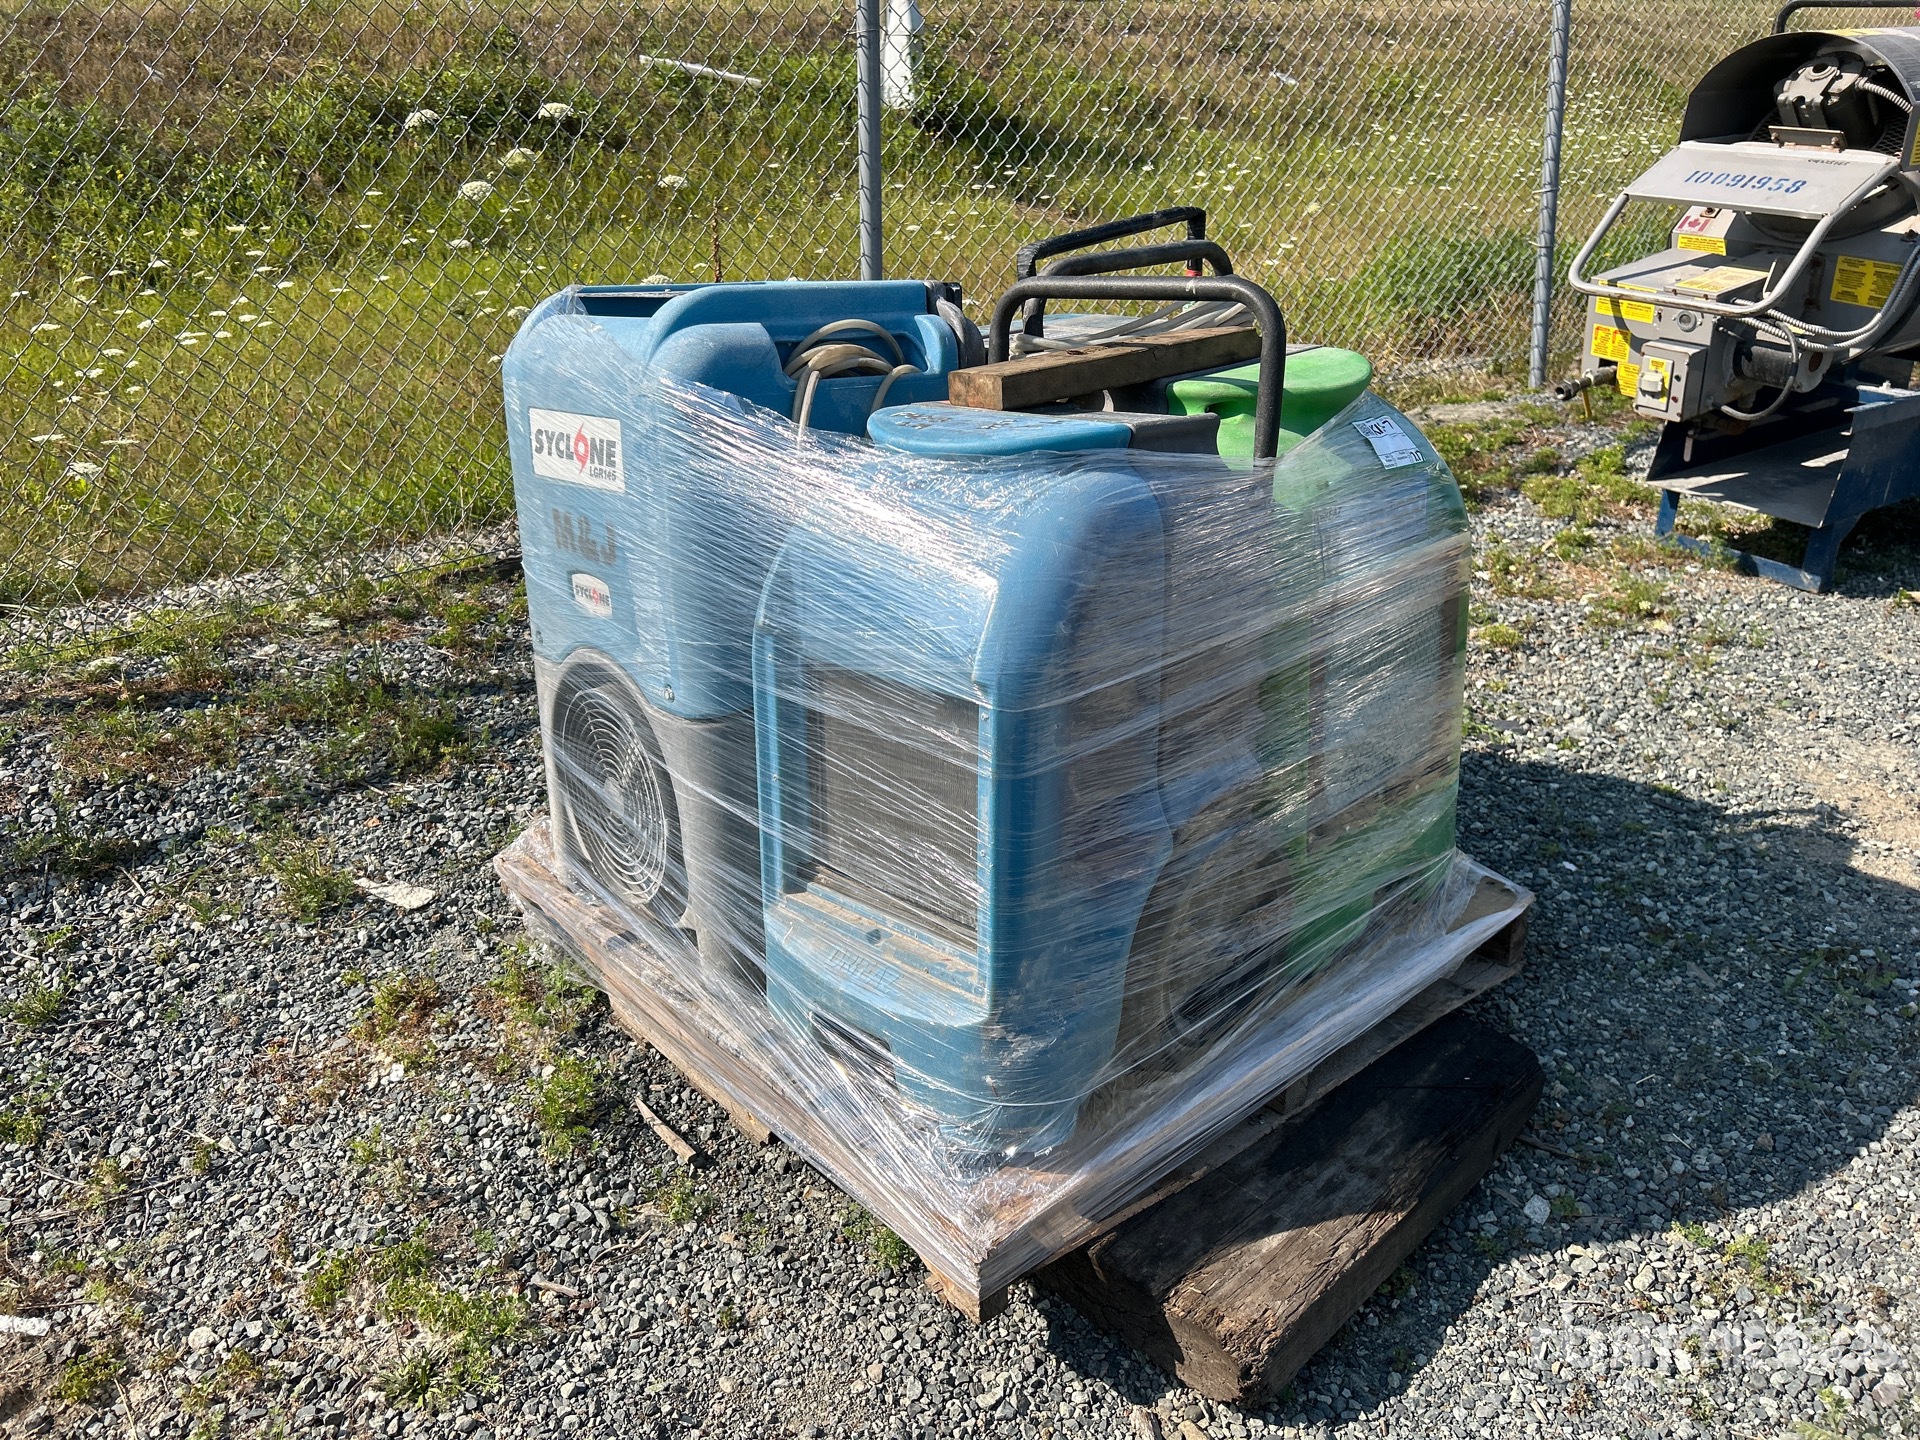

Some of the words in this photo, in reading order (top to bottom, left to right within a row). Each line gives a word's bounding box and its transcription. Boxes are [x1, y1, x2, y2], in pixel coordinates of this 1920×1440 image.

[1684, 170, 1808, 194] 10091958
[535, 424, 617, 474] SYCLONE
[589, 466, 617, 482] LGR145
